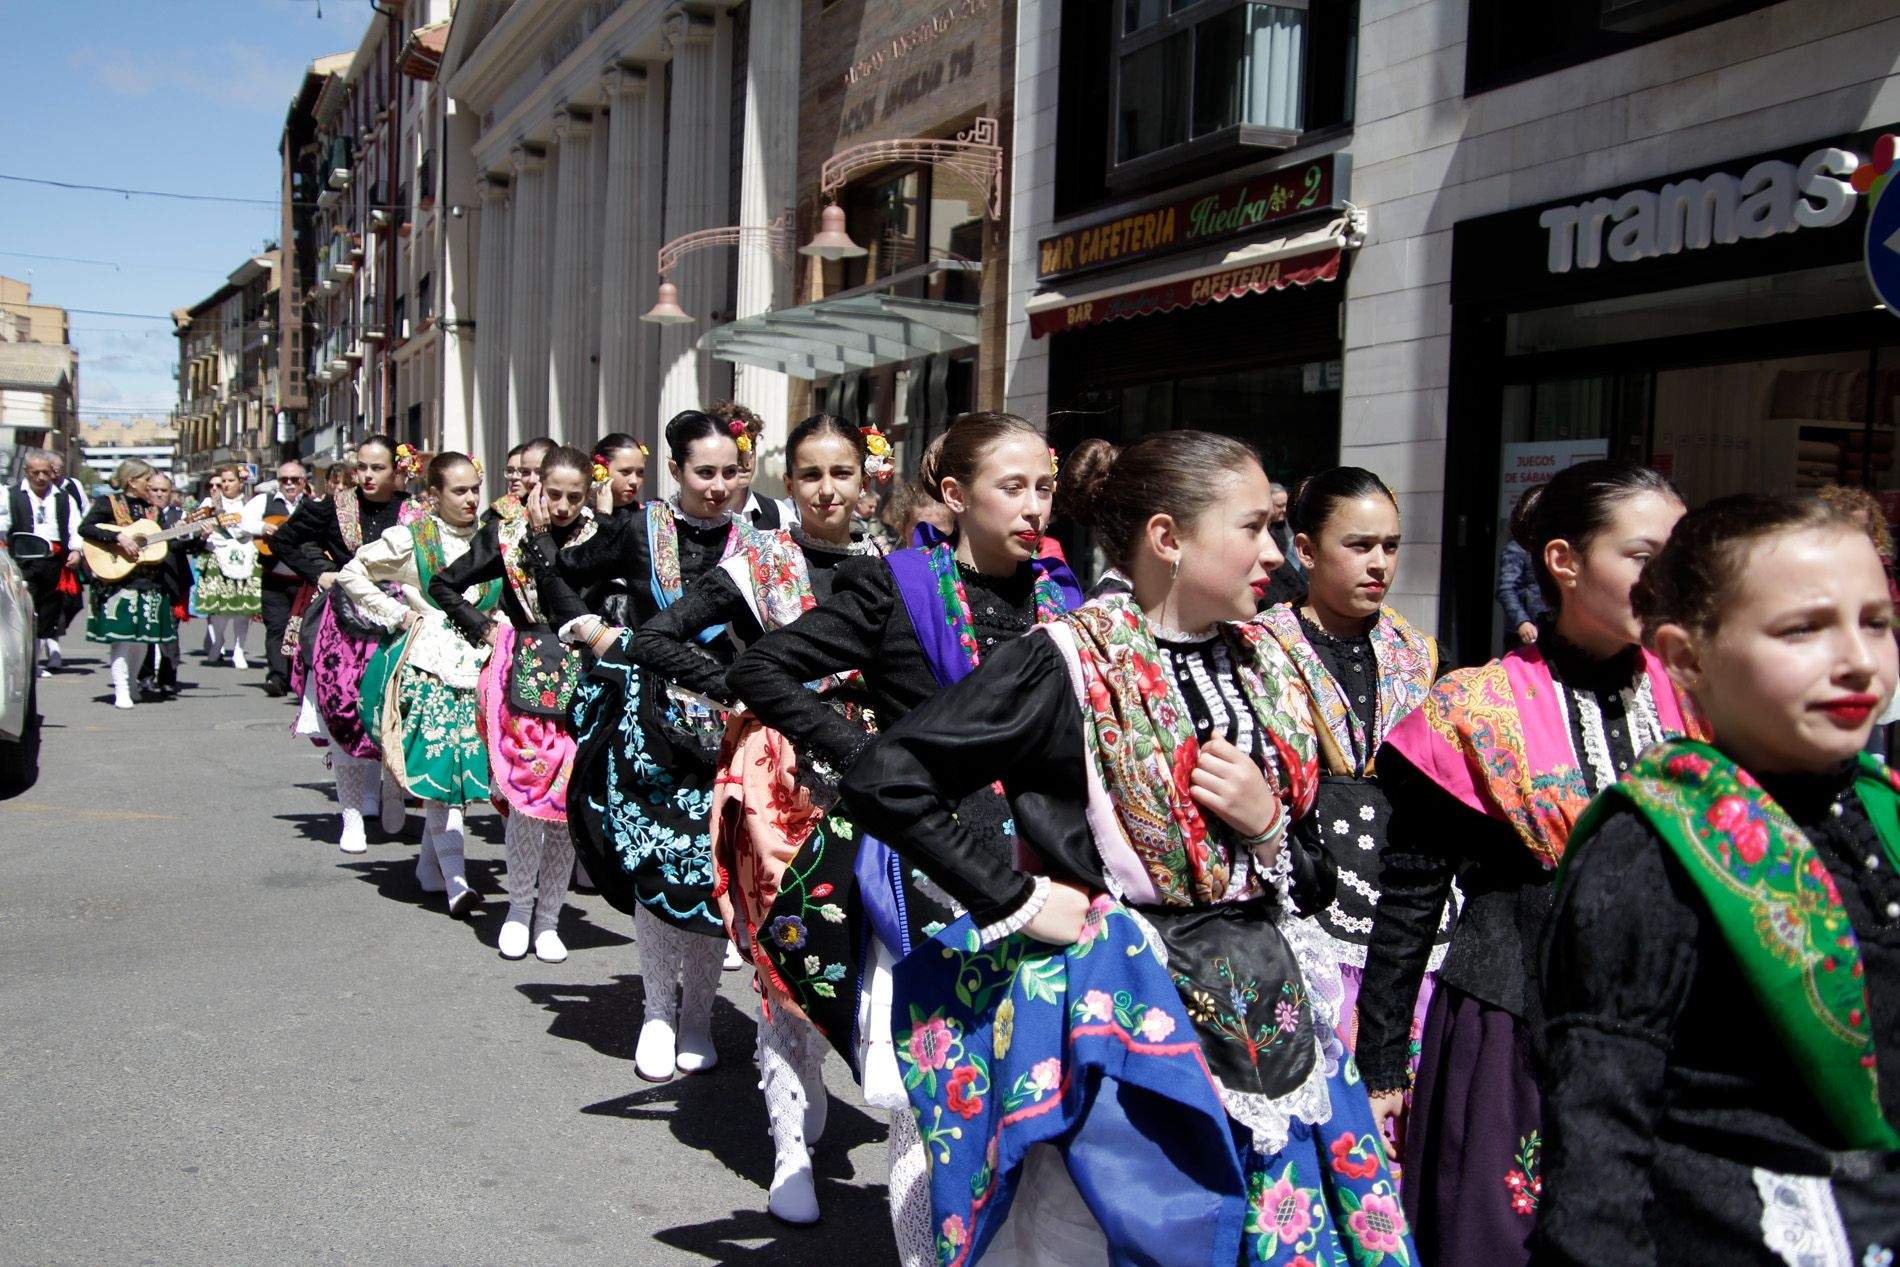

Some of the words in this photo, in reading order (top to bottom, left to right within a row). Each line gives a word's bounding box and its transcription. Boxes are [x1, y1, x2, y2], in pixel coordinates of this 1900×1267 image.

[1041, 236, 1074, 274] BAR
[1079, 207, 1175, 265] CAFETERIA
[1186, 186, 1271, 239] Hiedra
[1296, 165, 1322, 210] 2
[1066, 302, 1093, 326] BAR
[1190, 262, 1281, 301] CAFETERIA
[1504, 472, 1517, 484] DE
[1520, 470, 1553, 483] SÁBAN
[1516, 454, 1556, 468] JUEGOS
